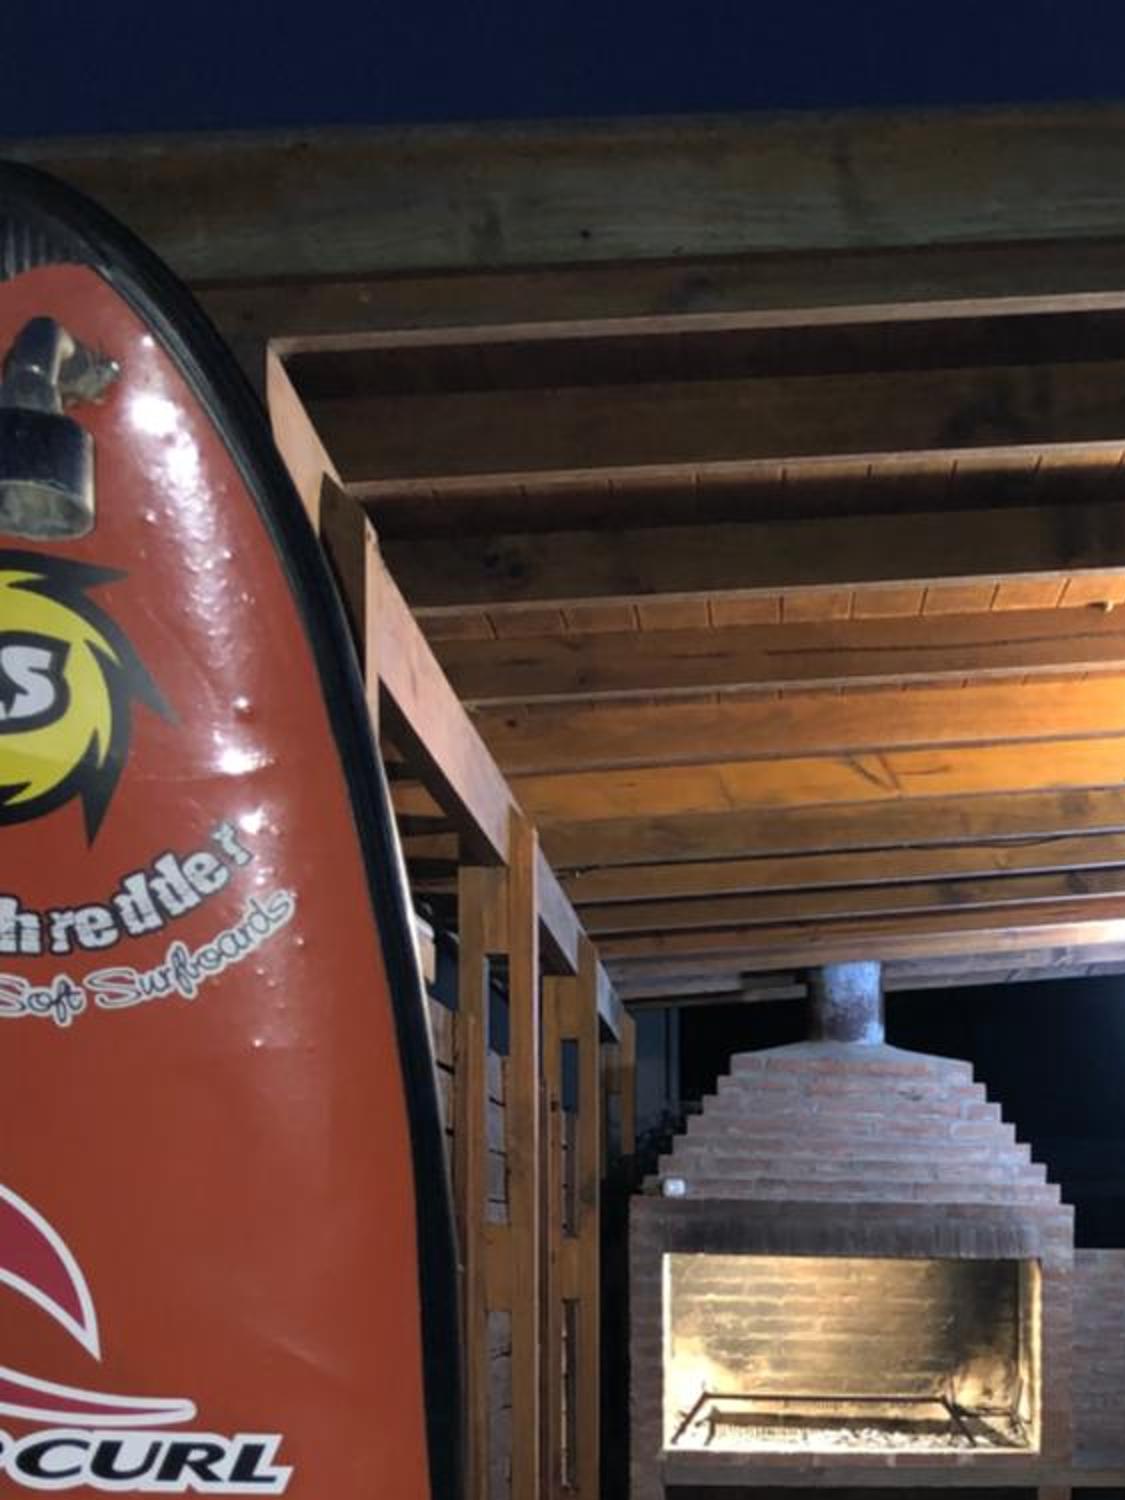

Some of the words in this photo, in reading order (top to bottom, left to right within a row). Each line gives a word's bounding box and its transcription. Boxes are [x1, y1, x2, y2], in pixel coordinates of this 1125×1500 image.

[0, 645, 56, 719] S
[84, 889, 296, 1007] Surfboards
[11, 1435, 285, 1487] CURL
